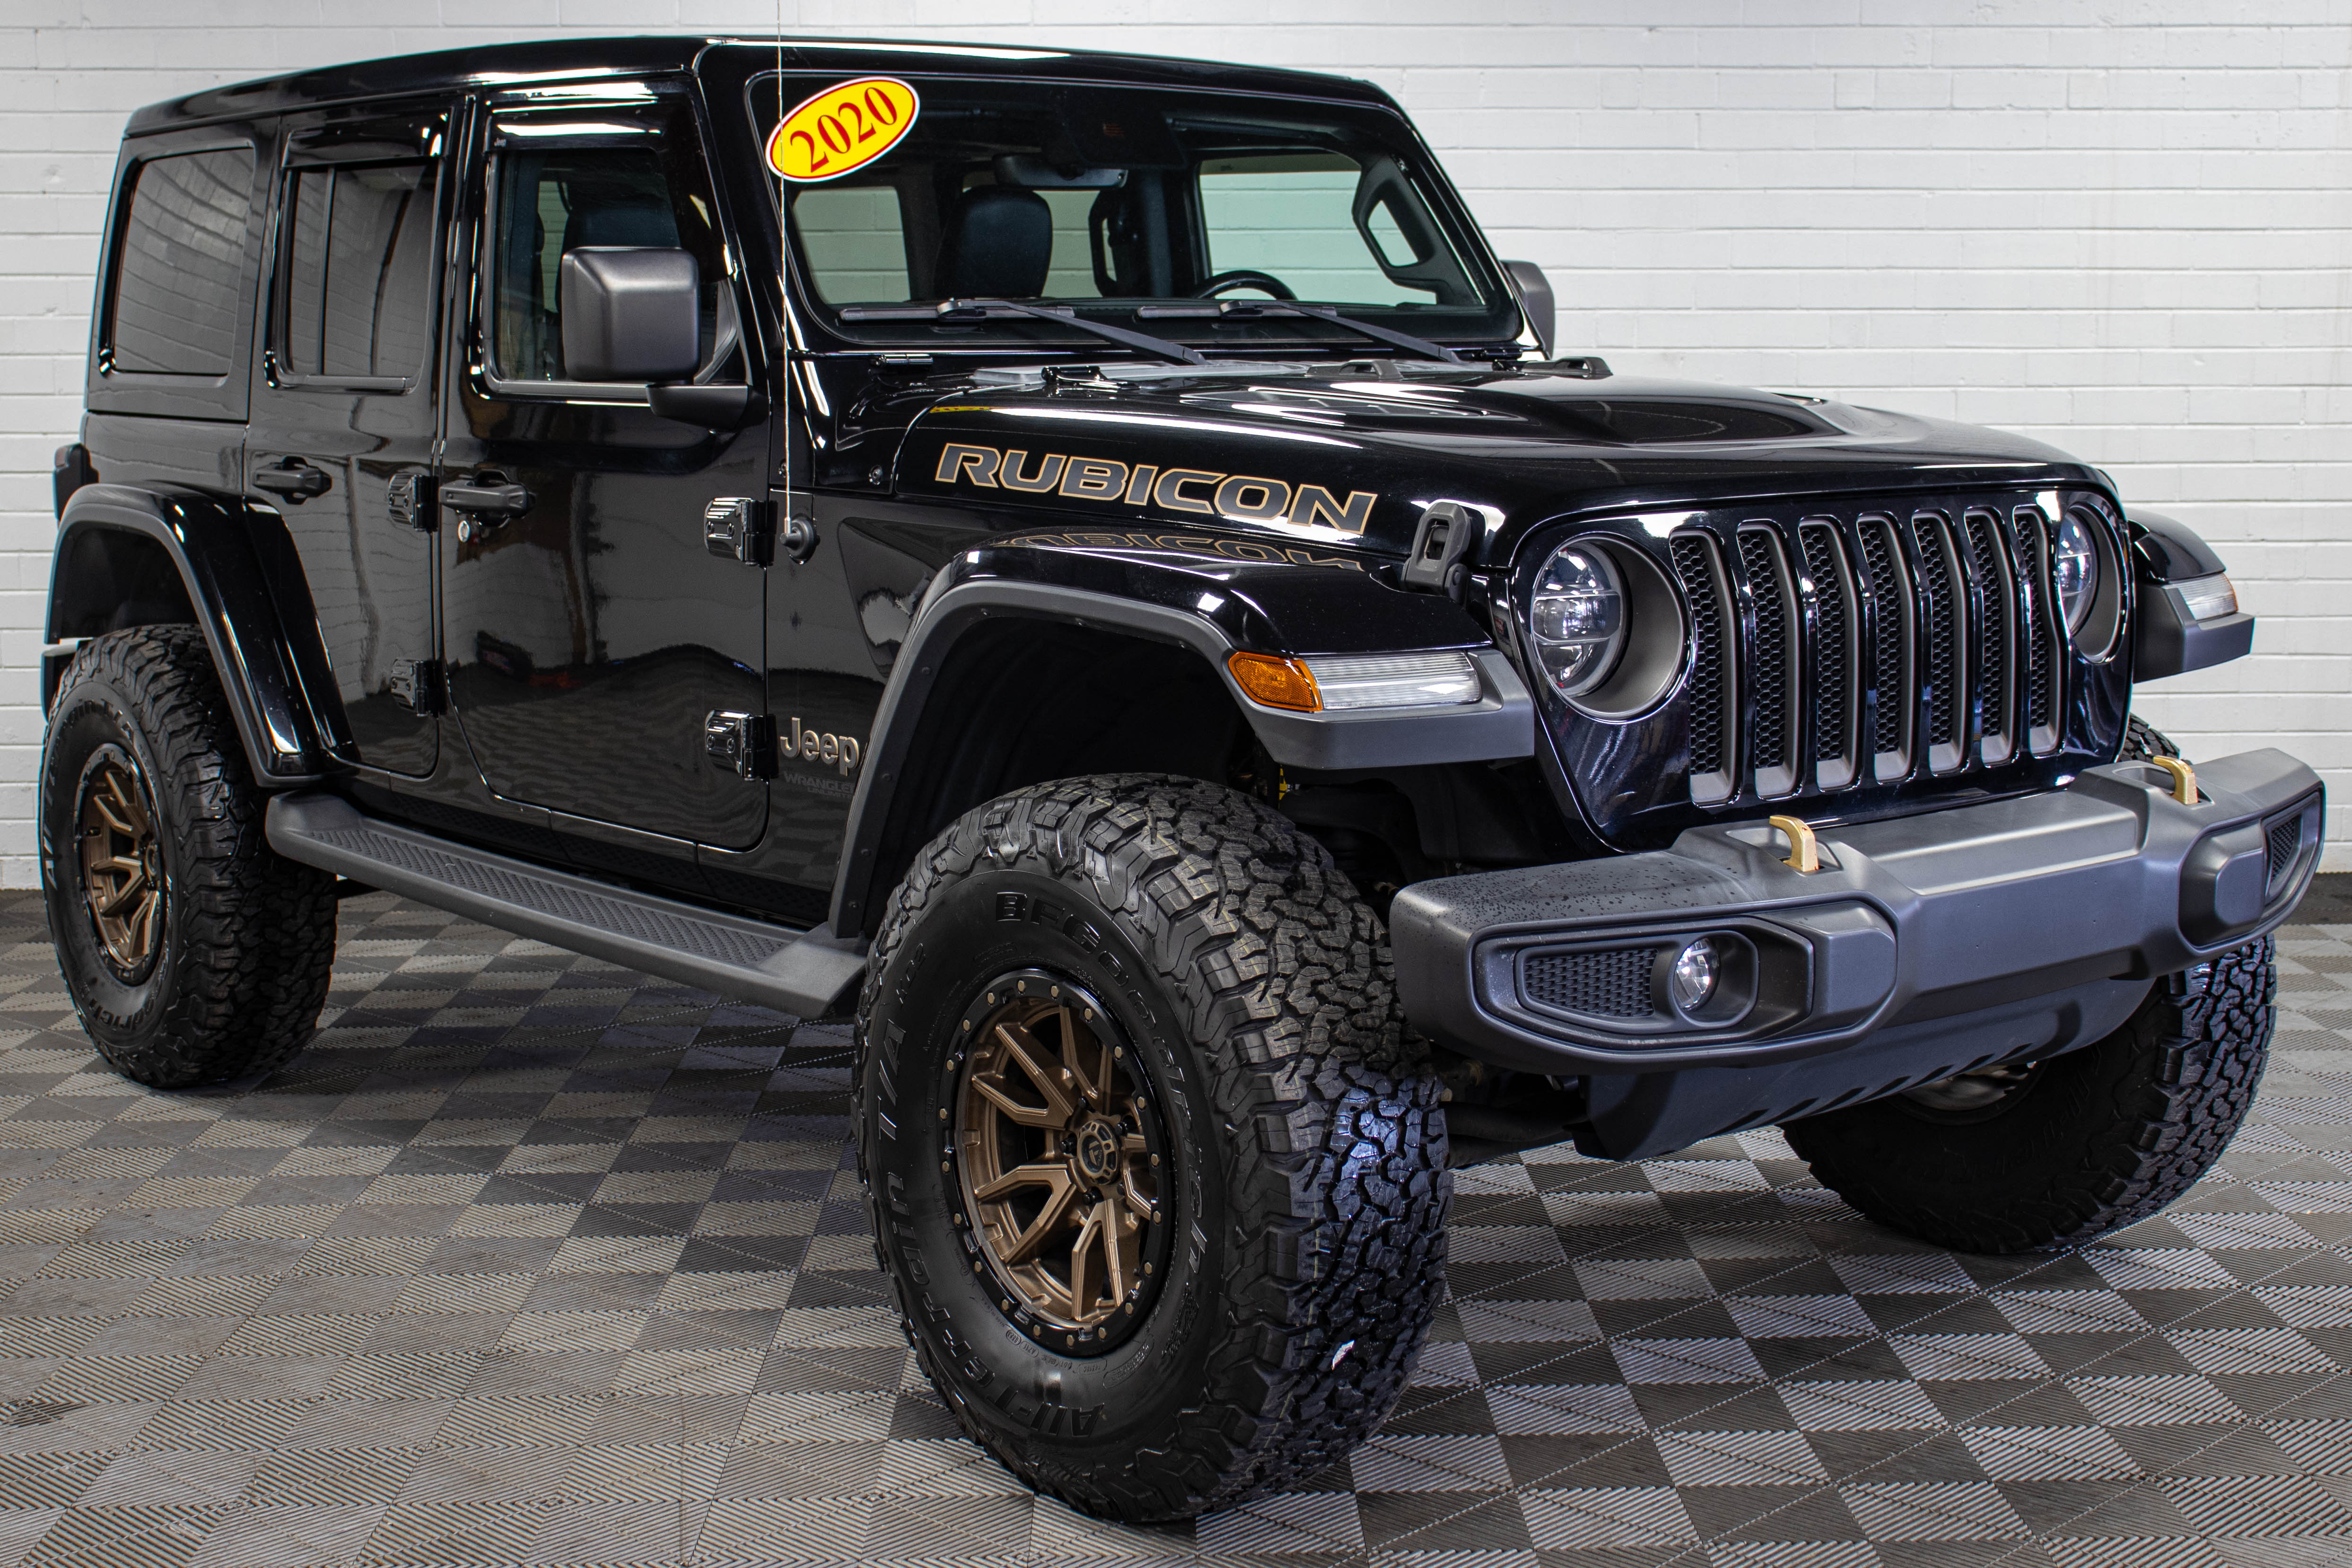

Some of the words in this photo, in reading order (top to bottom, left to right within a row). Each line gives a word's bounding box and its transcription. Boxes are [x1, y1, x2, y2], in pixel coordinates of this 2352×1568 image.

[790, 87, 897, 173] 2020
[935, 443, 1377, 534] RUBICON
[780, 717, 859, 777] Jeep
[807, 786, 852, 799] UNLIMITE
